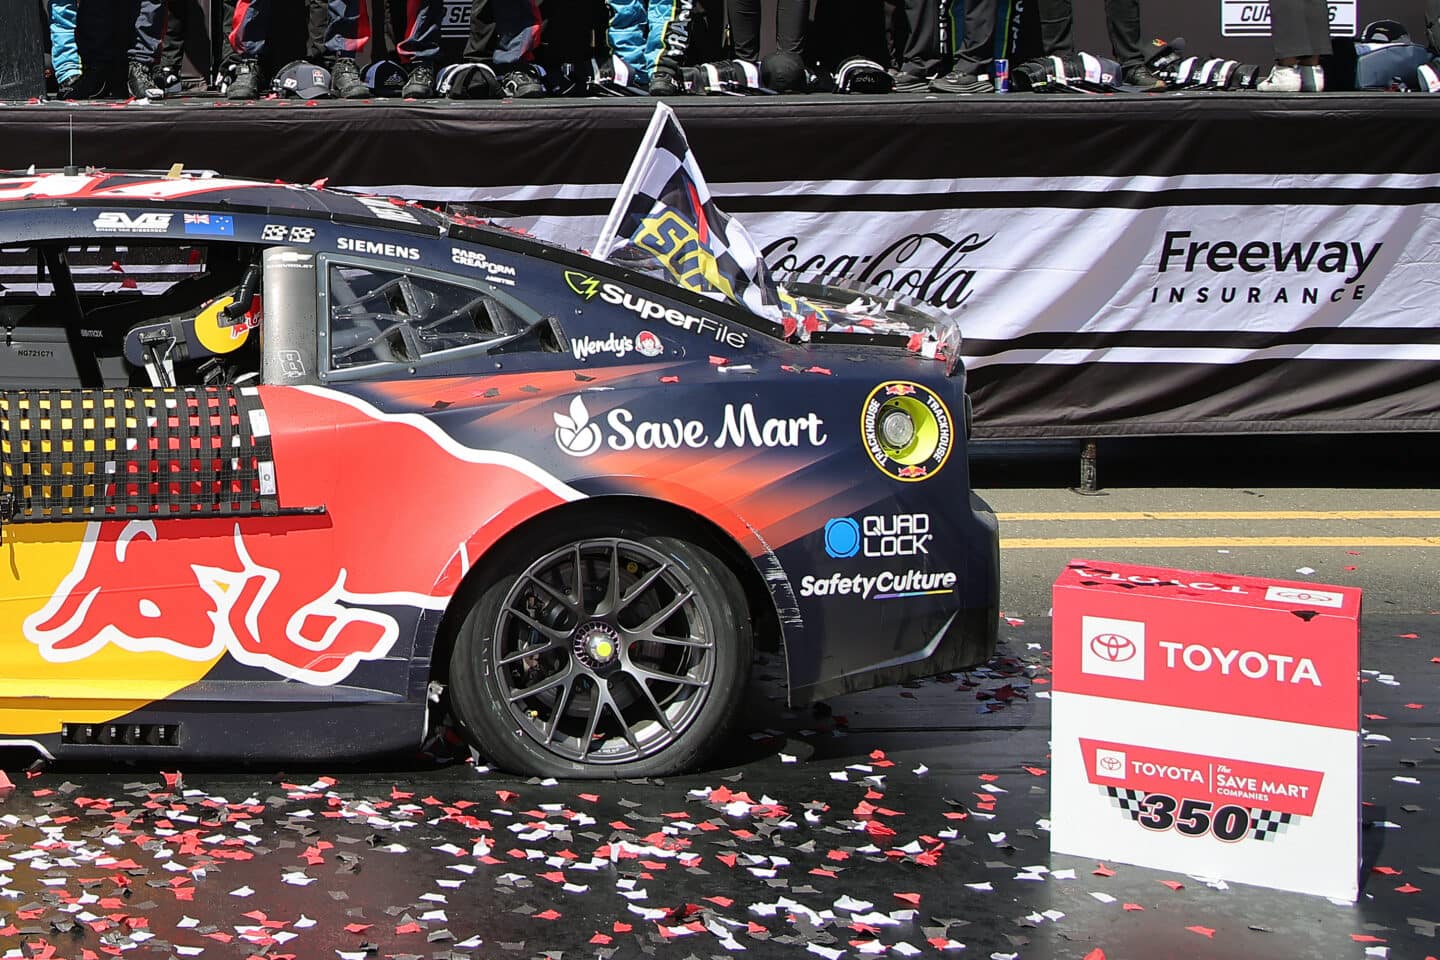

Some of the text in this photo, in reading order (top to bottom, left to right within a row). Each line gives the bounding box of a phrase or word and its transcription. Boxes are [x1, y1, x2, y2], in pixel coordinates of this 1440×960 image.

[283, 78, 298, 89] 97
[337, 238, 420, 261] SIEMENS
[1159, 230, 1383, 283] Freeway
[451, 256, 516, 277] CREAFORM
[1152, 284, 1365, 304] INSURANCE
[599, 283, 747, 348] SuperFile
[571, 332, 633, 360] Wendy's
[608, 403, 827, 449] Save Mart
[865, 398, 888, 467] TRACKHOUSE
[926, 395, 950, 463] TRACKHOUSE
[863, 513, 929, 536] QUAD
[864, 534, 929, 557] LOCK
[800, 570, 957, 600] SafetyCulture
[1159, 641, 1322, 686] TOYOTA
[1131, 760, 1205, 784] TOYOTA
[1216, 764, 1232, 774] The
[1216, 774, 1309, 800] SAVE MART
[1216, 787, 1269, 802] COMPANIES
[1137, 794, 1252, 843] 350
